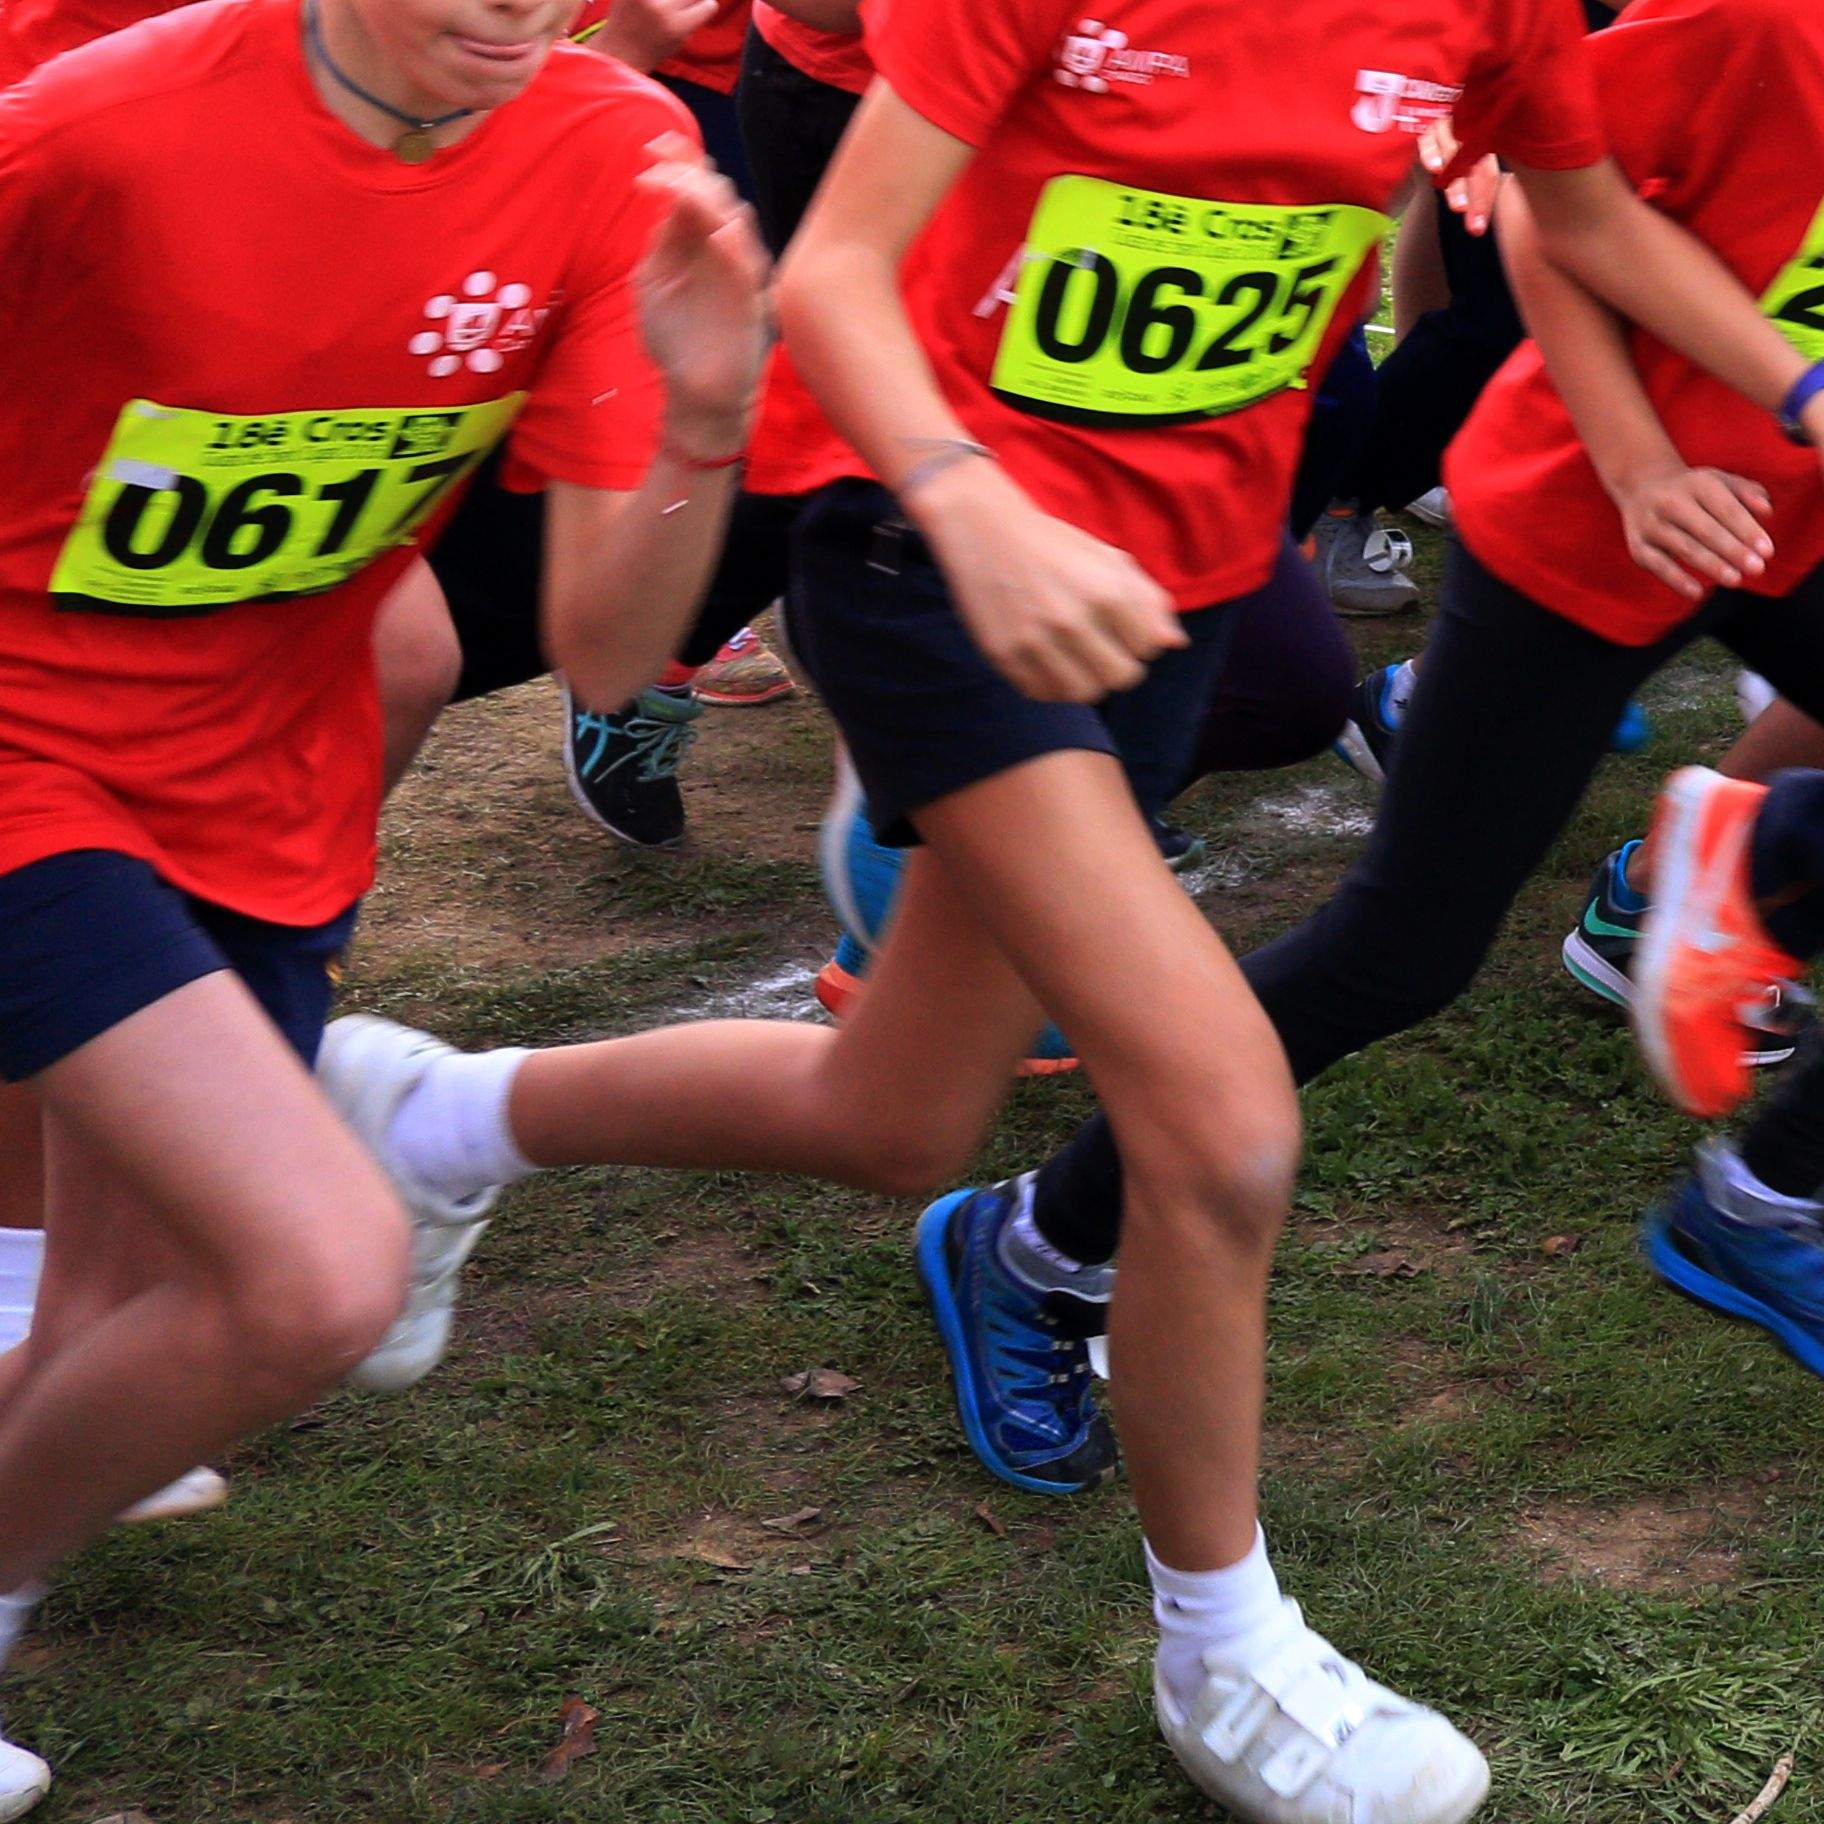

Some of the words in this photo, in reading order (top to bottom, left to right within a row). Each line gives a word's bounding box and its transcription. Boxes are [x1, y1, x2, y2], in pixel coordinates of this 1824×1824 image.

[1035, 248, 1340, 375] 0625
[302, 416, 389, 443] Cros
[103, 451, 480, 570] 0617
